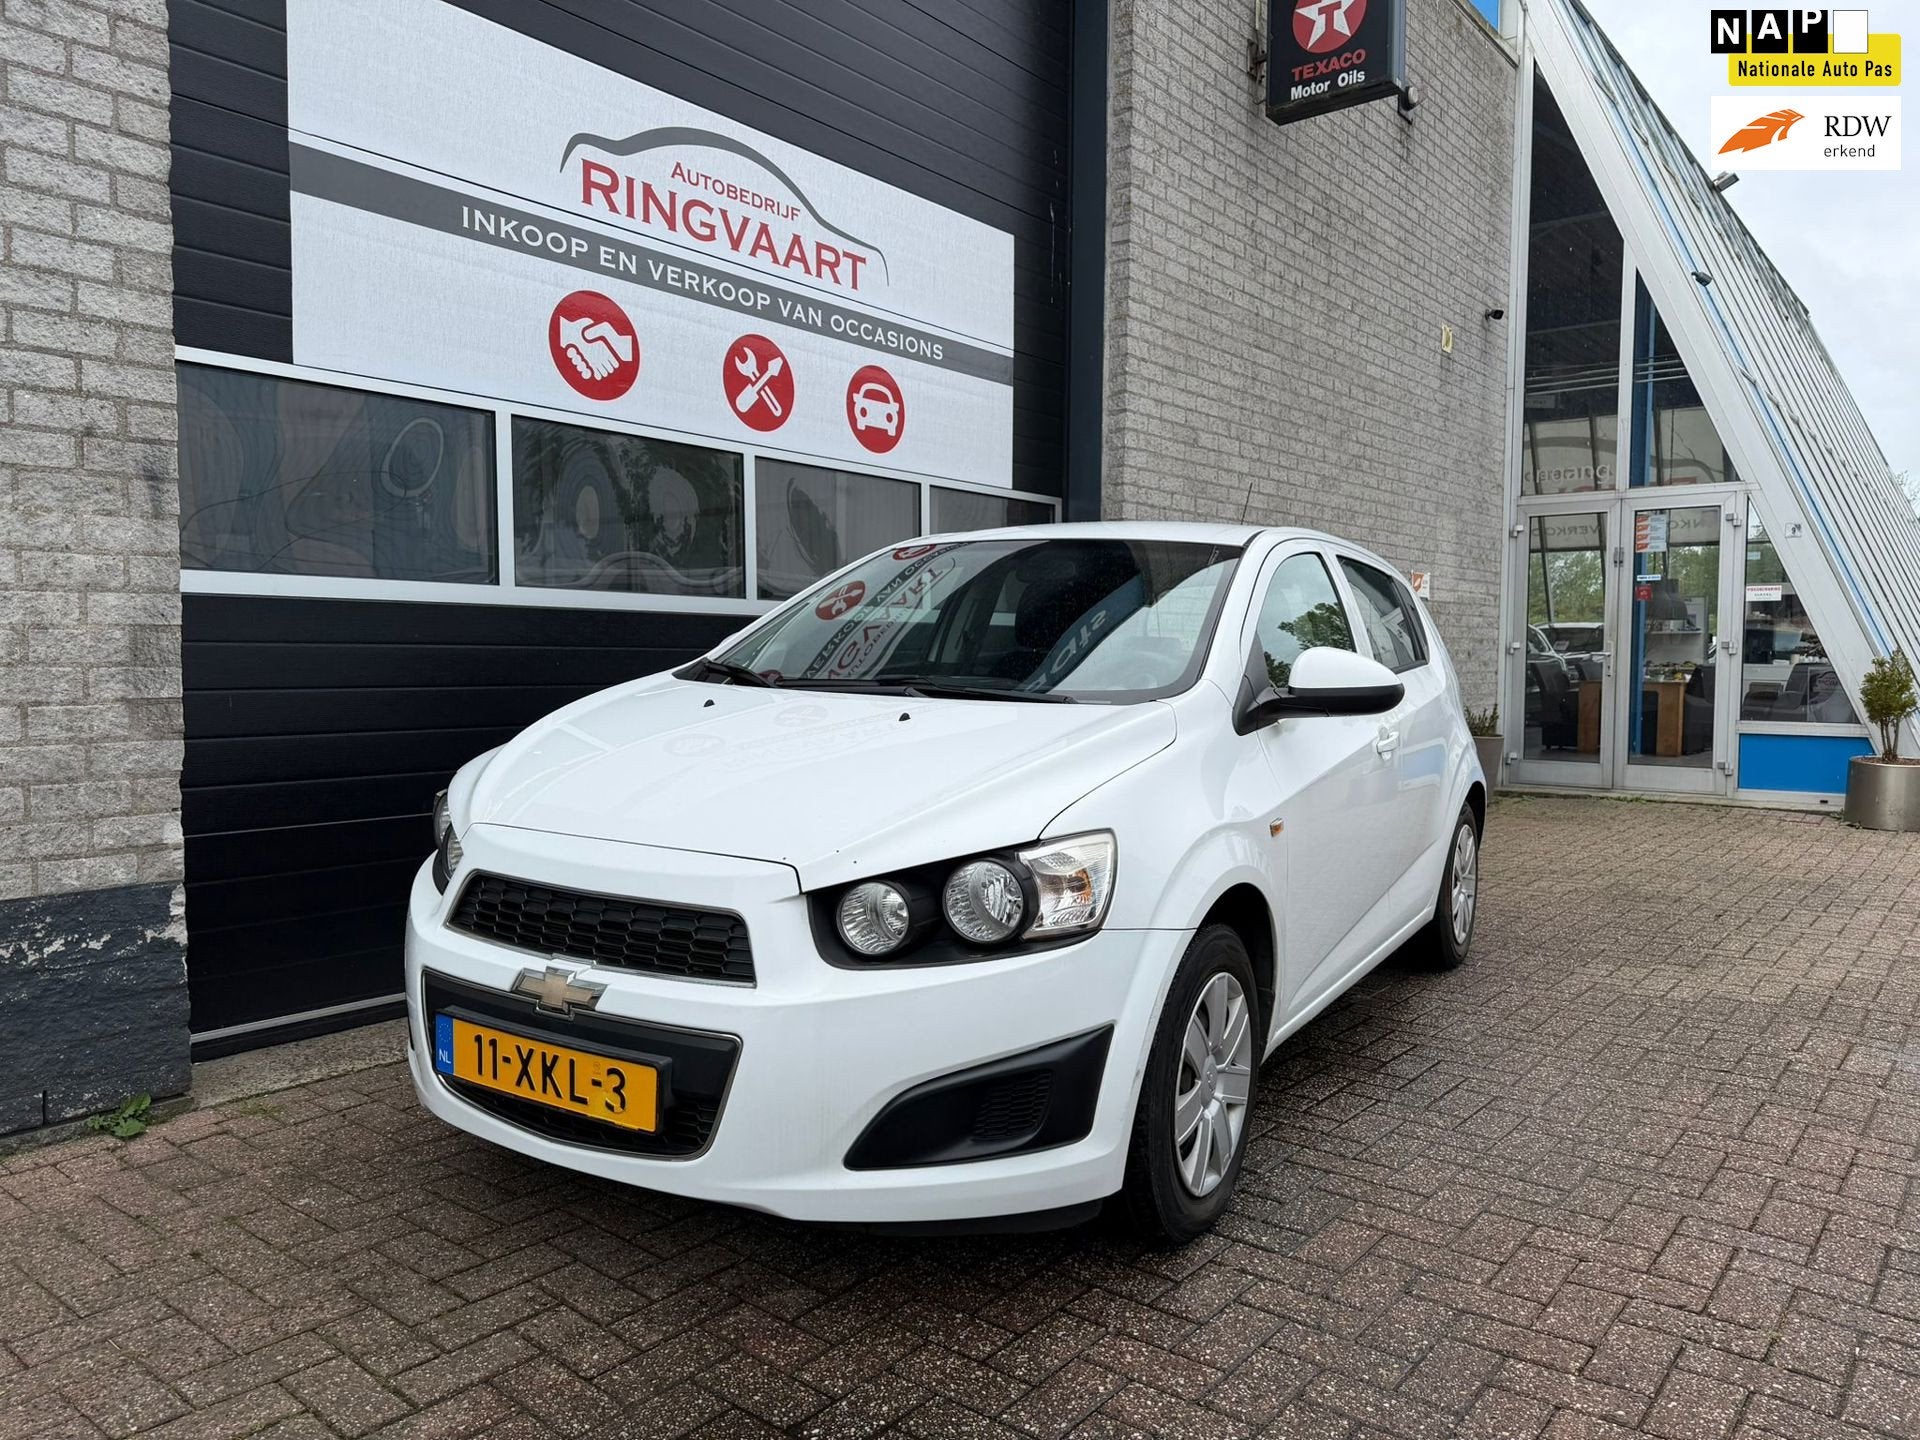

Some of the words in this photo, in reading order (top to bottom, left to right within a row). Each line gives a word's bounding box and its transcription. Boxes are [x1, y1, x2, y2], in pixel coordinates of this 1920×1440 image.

[1290, 80, 1331, 100] Motor
[1337, 69, 1366, 88] Oils
[1291, 48, 1367, 81] TEXACO
[670, 161, 801, 222] AUTOBEDRIJF
[581, 157, 867, 291] RINGVAART
[462, 206, 589, 259] INKOOP
[600, 246, 637, 275] EN
[647, 260, 771, 312] VERKOOP
[777, 297, 822, 328] VAN
[830, 315, 944, 361] OCCASIONS
[438, 1049, 451, 1064] NL
[474, 1032, 626, 1114] 11-XKL-3
